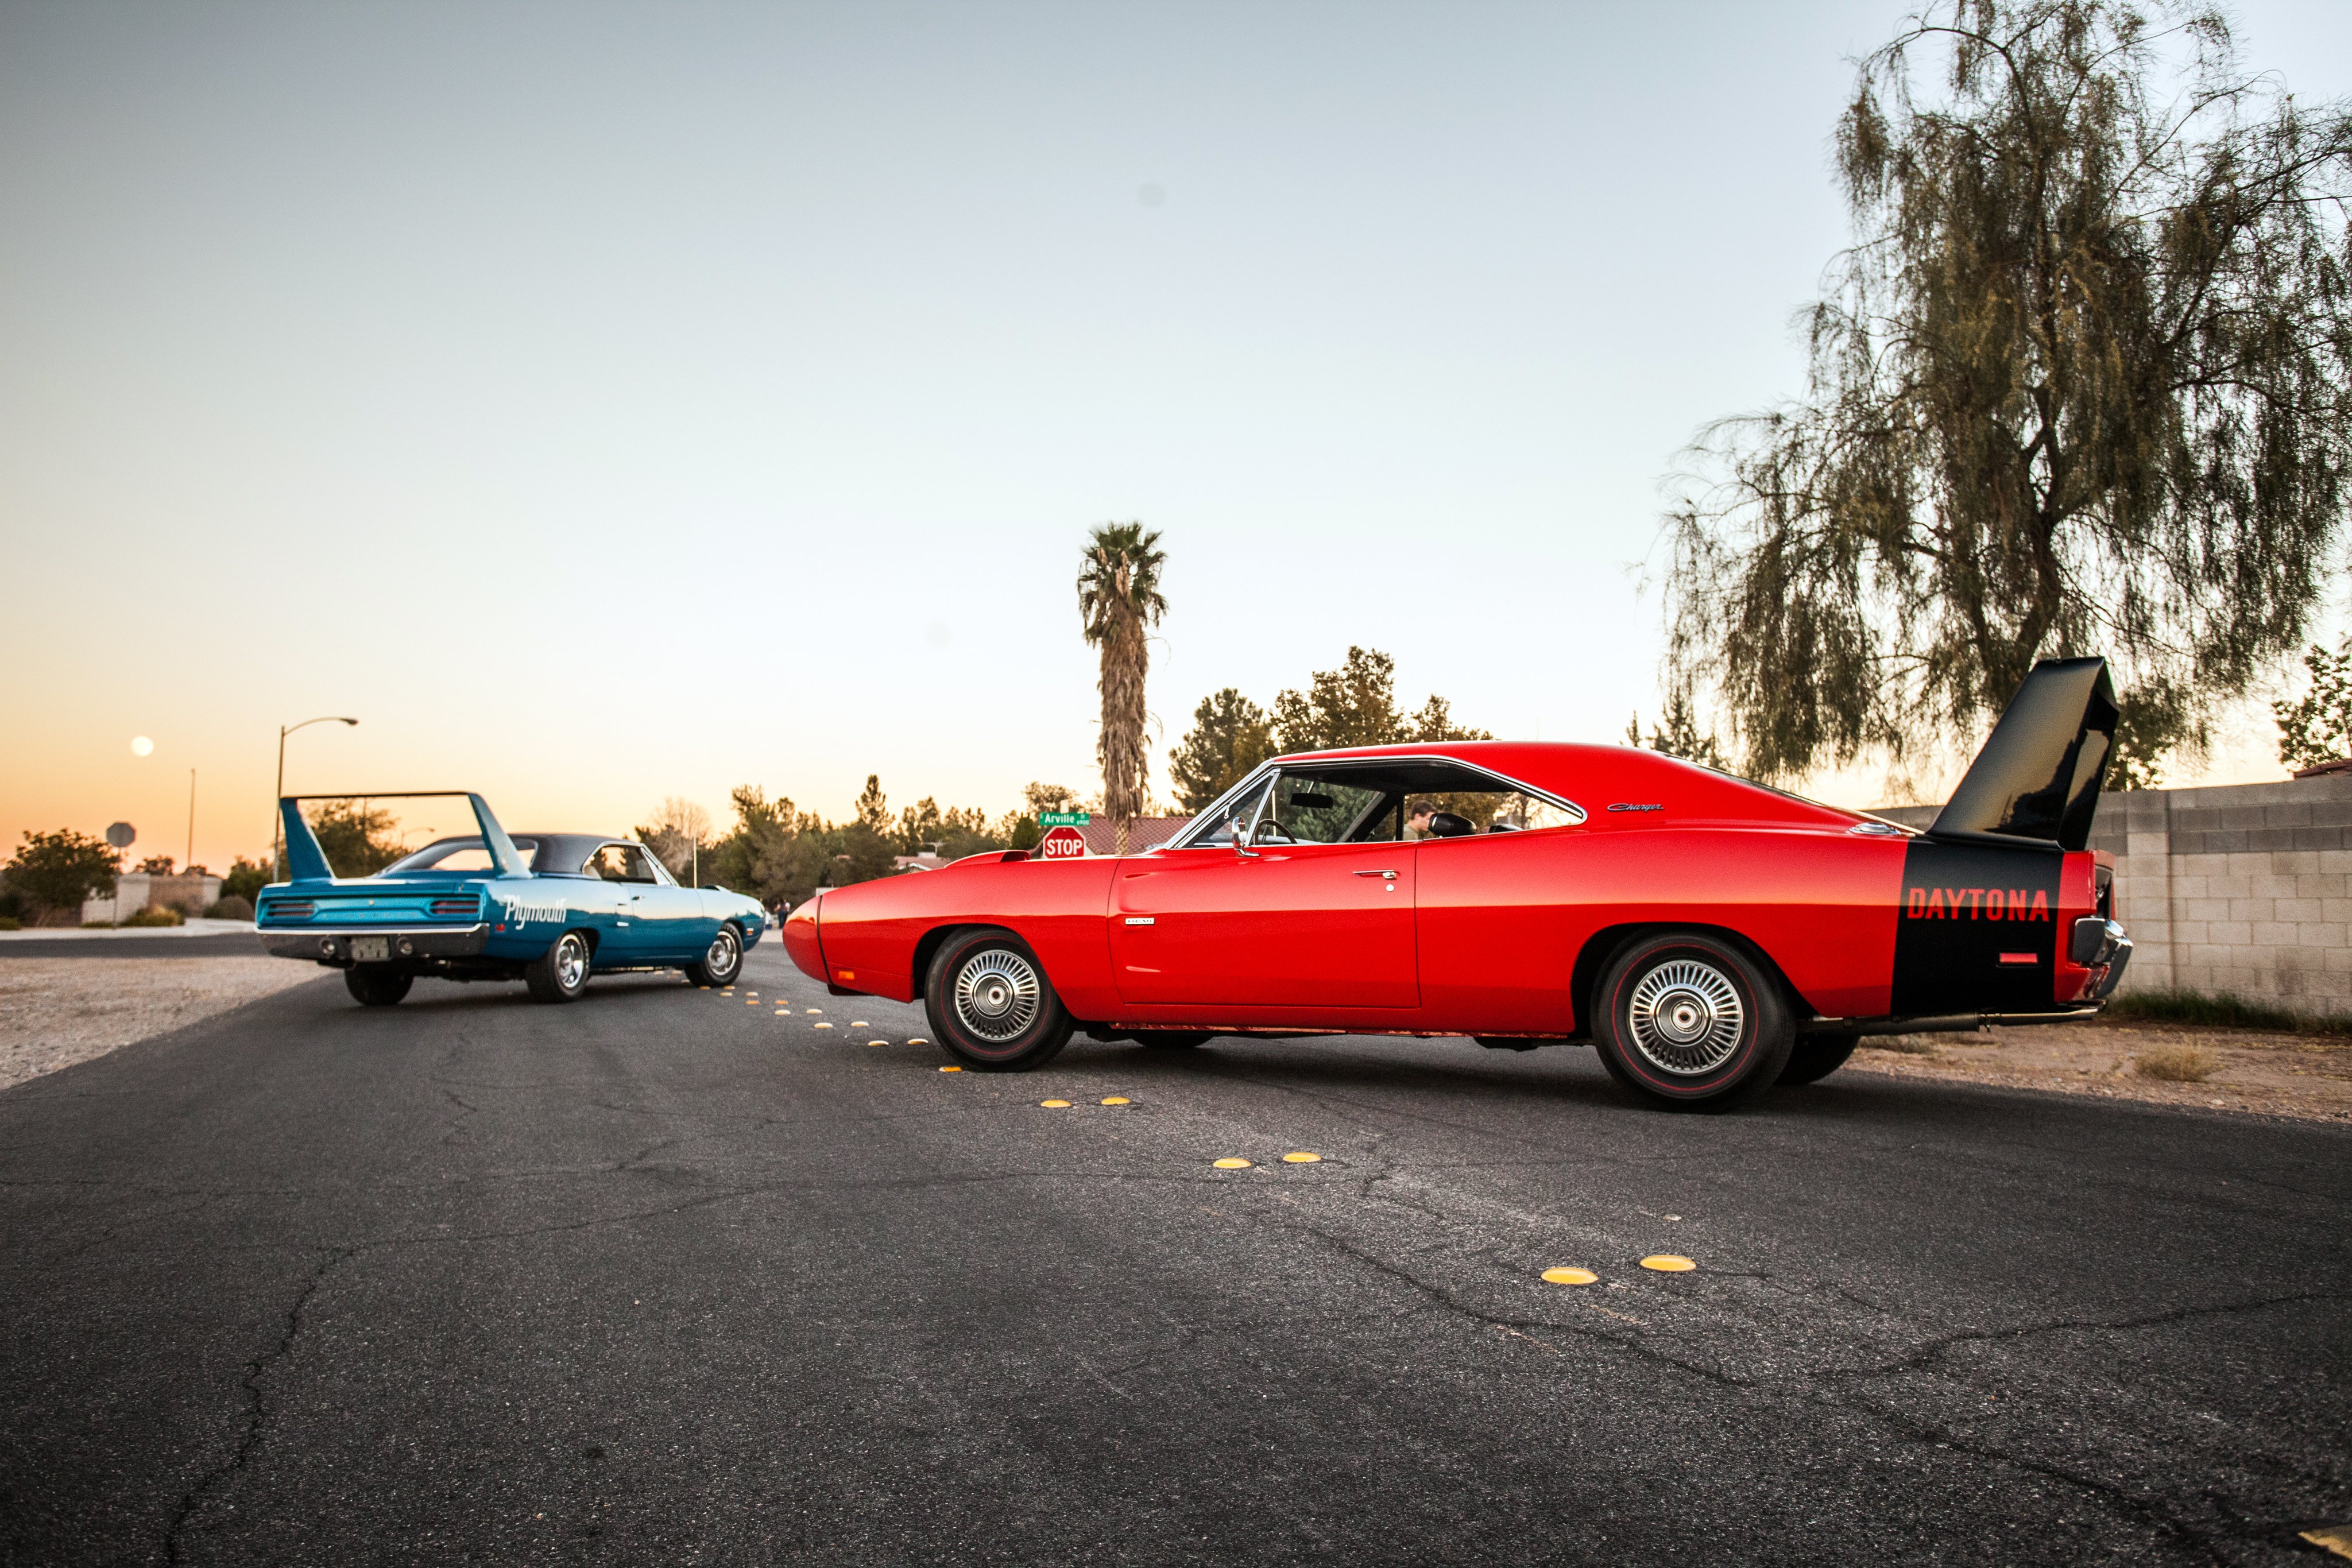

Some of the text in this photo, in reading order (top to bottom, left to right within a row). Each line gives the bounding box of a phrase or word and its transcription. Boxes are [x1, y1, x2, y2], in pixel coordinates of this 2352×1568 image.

[1607, 803, 1664, 812] Charger
[1045, 813, 1074, 823] Arville
[1046, 839, 1083, 855] STOP
[504, 895, 567, 930] Plymouth
[1907, 888, 2049, 922] DAYTONA
